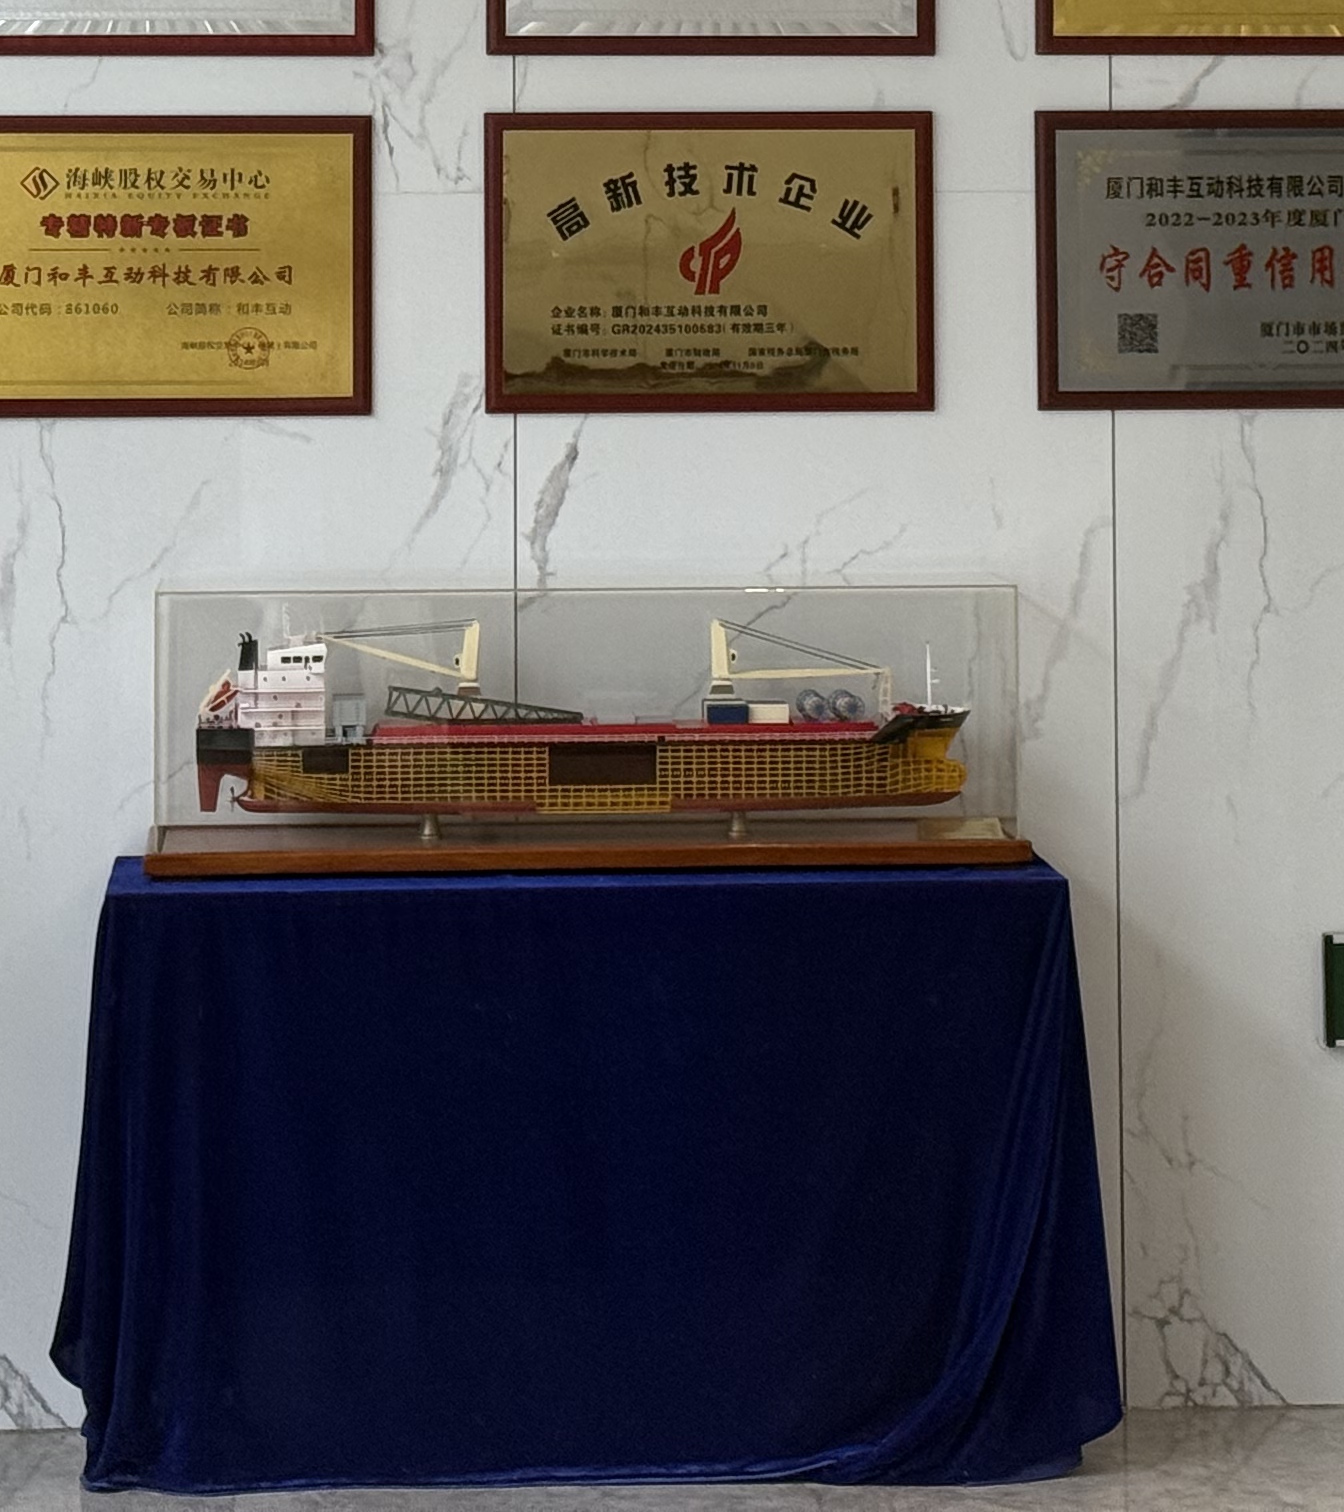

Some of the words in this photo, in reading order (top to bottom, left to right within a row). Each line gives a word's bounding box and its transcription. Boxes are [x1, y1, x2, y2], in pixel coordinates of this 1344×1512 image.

[65, 166, 271, 190] 海峡股权交易中心
[1105, 174, 1344, 199] 厦门和丰互动科技有限公司
[547, 161, 874, 242] 高新技术企业
